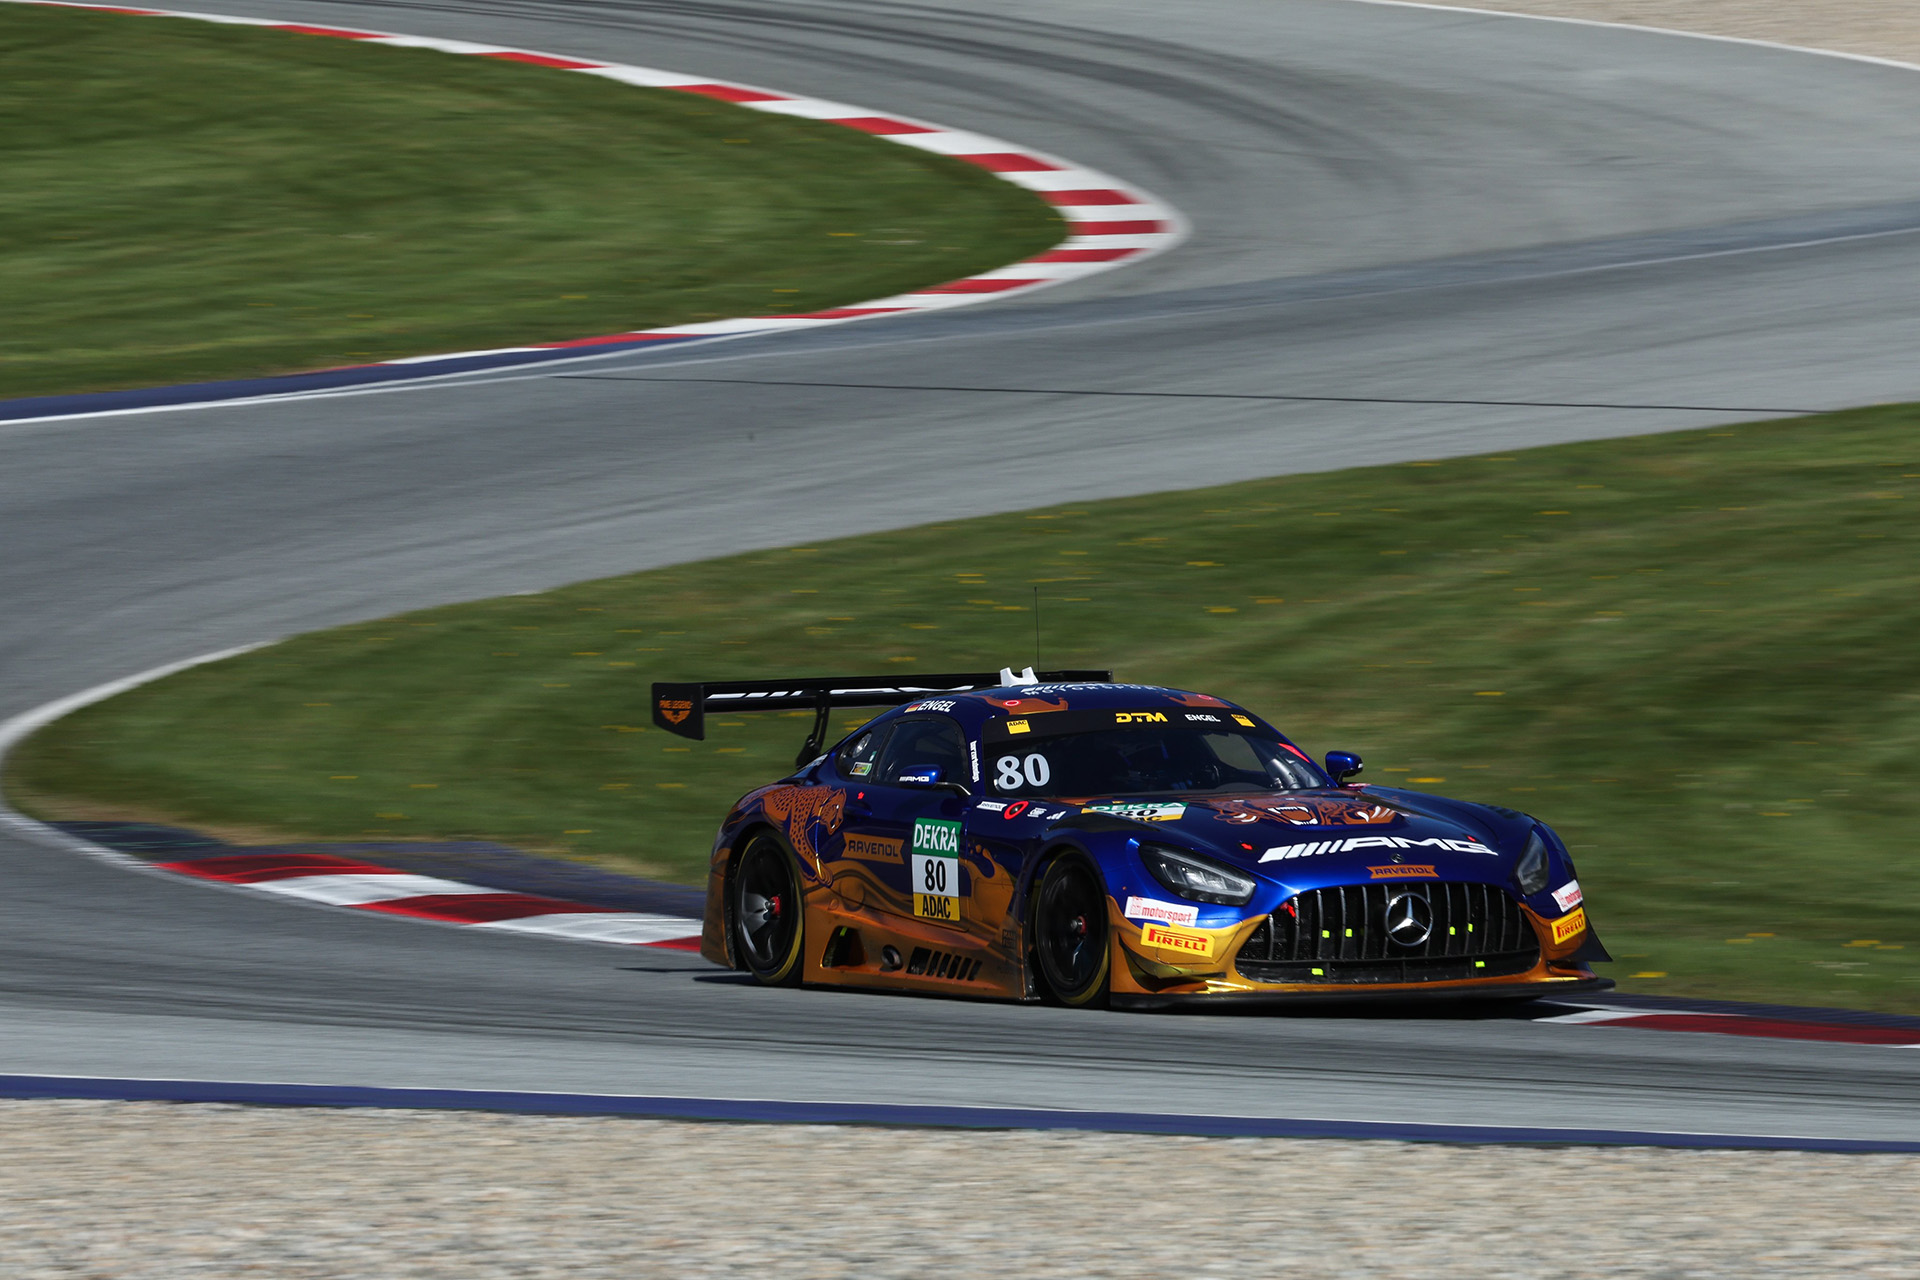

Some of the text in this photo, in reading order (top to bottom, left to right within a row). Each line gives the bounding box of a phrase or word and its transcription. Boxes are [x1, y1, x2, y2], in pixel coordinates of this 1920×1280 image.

[917, 700, 956, 713] ENGEL
[1009, 719, 1027, 727] ADAC
[1115, 712, 1168, 723] DTM
[1185, 714, 1221, 723] ENGEL
[997, 753, 1050, 790] 80
[1091, 802, 1184, 811] DEKRA
[913, 823, 958, 852] DEKRA
[1338, 836, 1499, 856] AMG
[849, 840, 899, 857] RAVENOL
[925, 859, 946, 892] 80
[1374, 866, 1433, 876] RAVENOL
[922, 895, 951, 919] ADAC
[1141, 906, 1192, 924] motorsport
[1556, 913, 1584, 938] PIRELLI
[1148, 928, 1208, 952] PIRELLI
